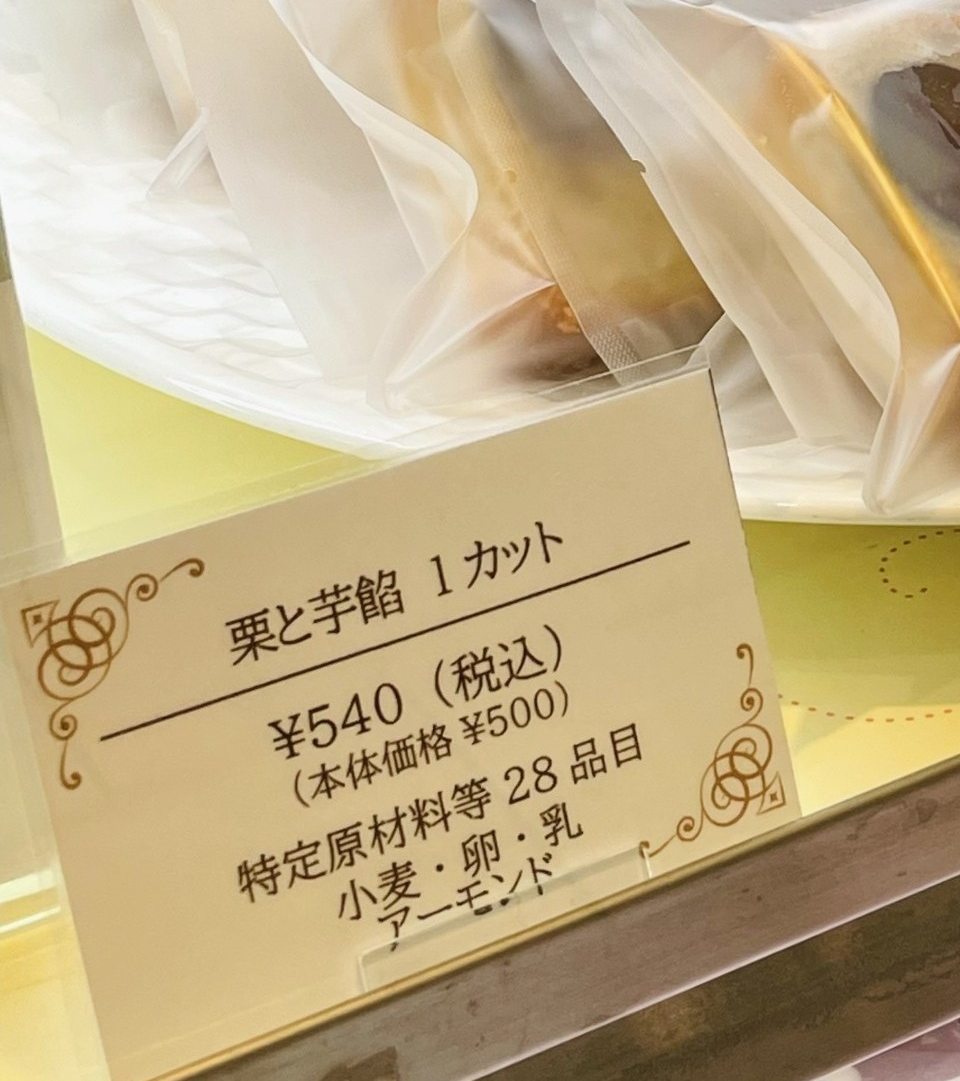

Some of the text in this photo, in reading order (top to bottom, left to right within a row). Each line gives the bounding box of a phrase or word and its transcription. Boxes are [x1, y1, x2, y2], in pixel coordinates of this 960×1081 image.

[225, 569, 404, 666] 栗と芋餡
[268, 683, 403, 760] ¥540
[378, 852, 552, 952] アーモンド
